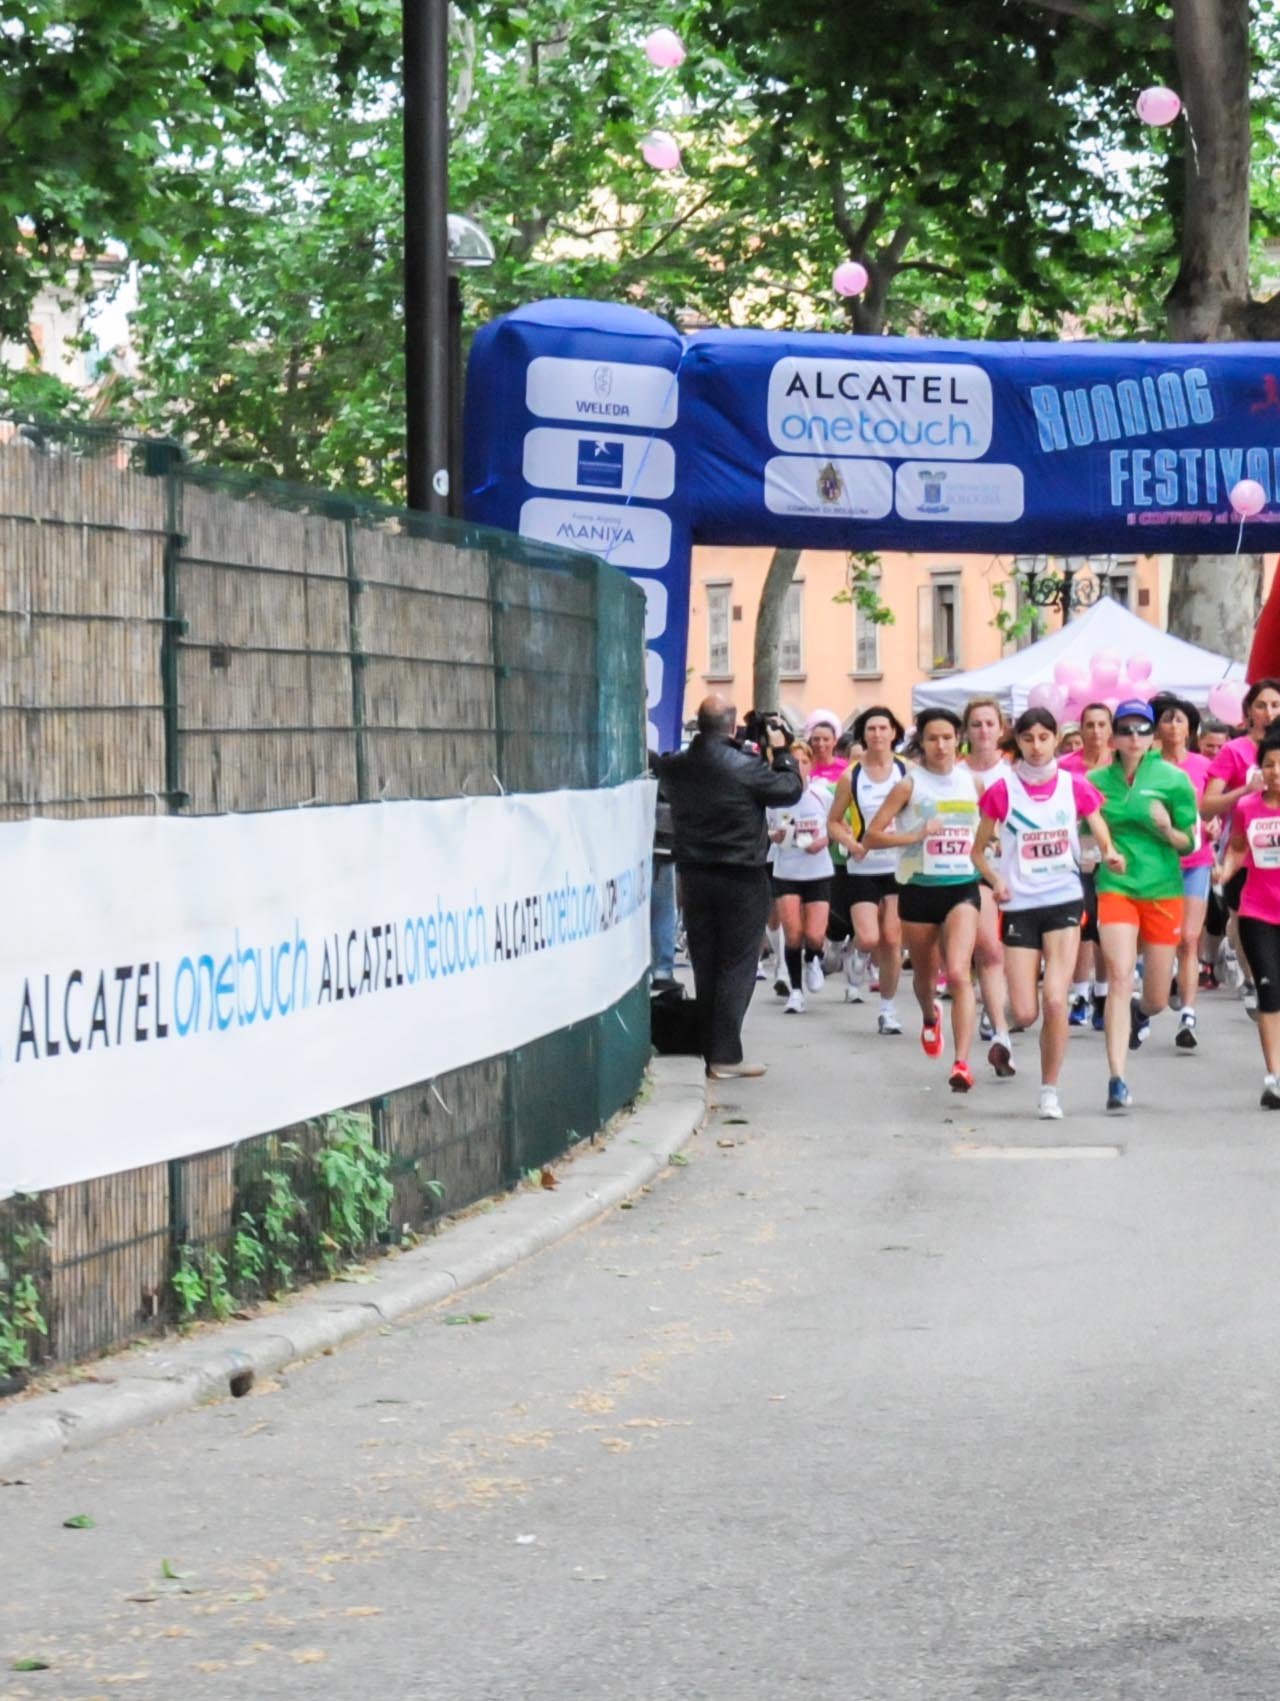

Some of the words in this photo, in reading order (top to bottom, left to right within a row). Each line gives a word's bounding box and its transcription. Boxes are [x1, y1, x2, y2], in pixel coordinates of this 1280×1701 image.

[785, 371, 969, 404] ALCATEL
[576, 400, 630, 417] WELEDA
[557, 522, 635, 543] MANIVA
[935, 840, 967, 855] 157
[15, 961, 168, 1063] ALCATEL
[318, 923, 404, 1005] ALCATEL
[494, 895, 547, 962] ALCATEL
